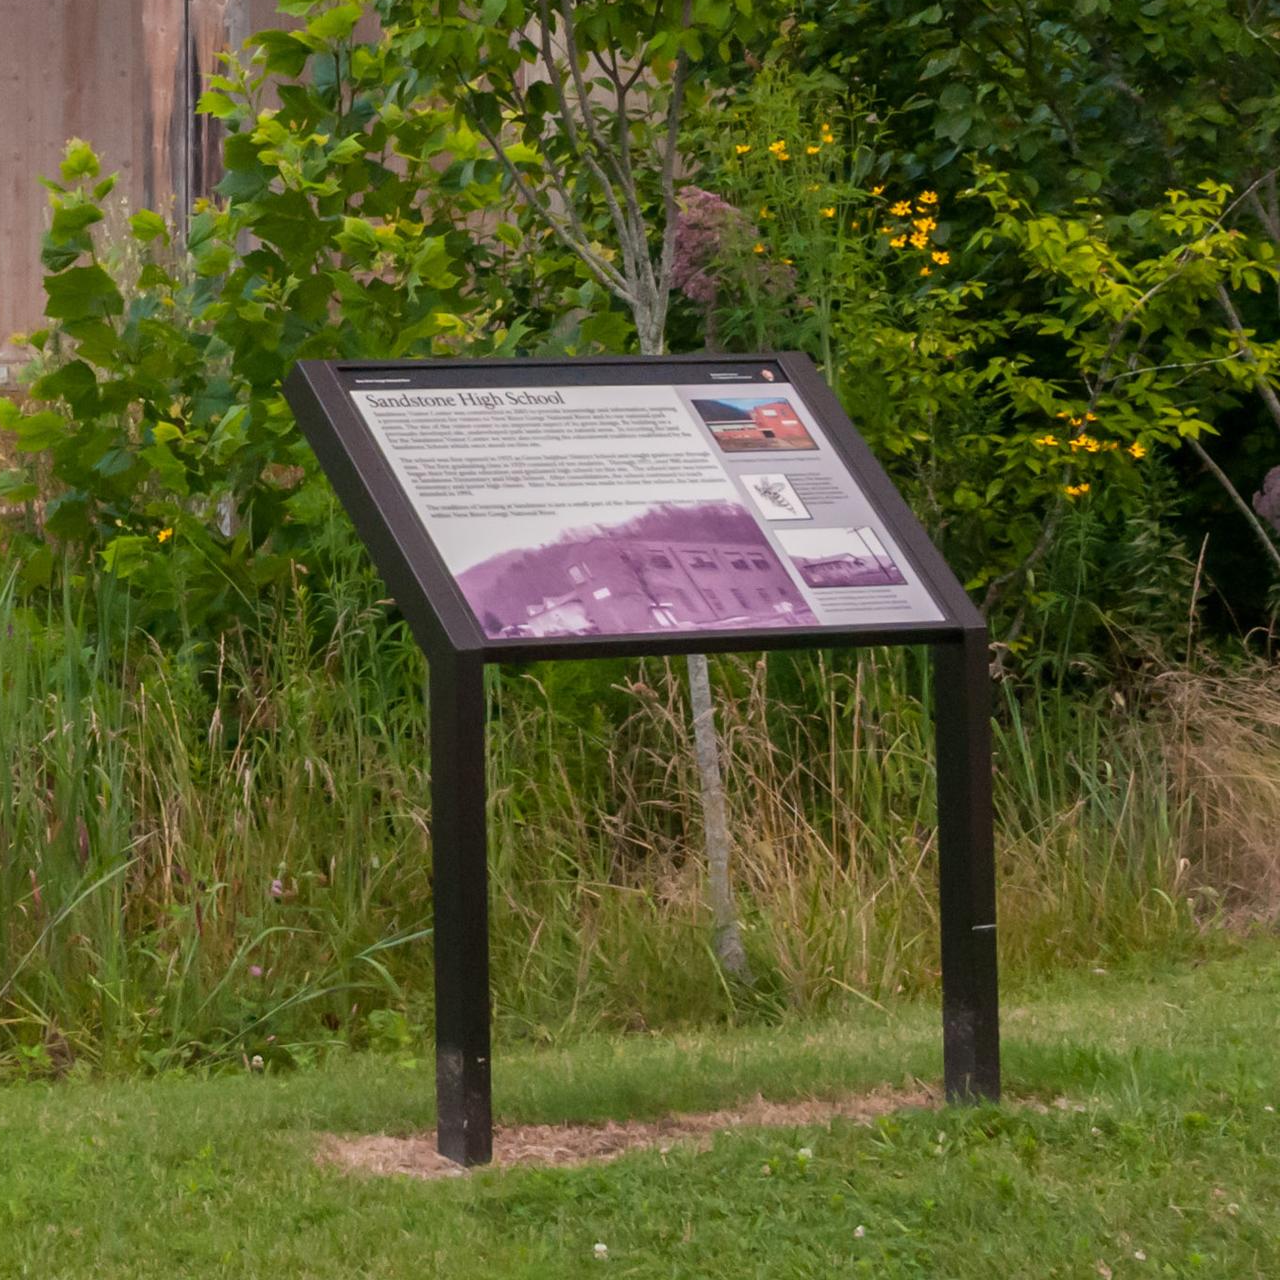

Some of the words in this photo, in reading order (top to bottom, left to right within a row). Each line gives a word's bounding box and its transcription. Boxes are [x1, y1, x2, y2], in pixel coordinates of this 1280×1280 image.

[365, 393, 456, 409] Sandstone
[457, 392, 504, 410] High
[504, 390, 566, 407] School
